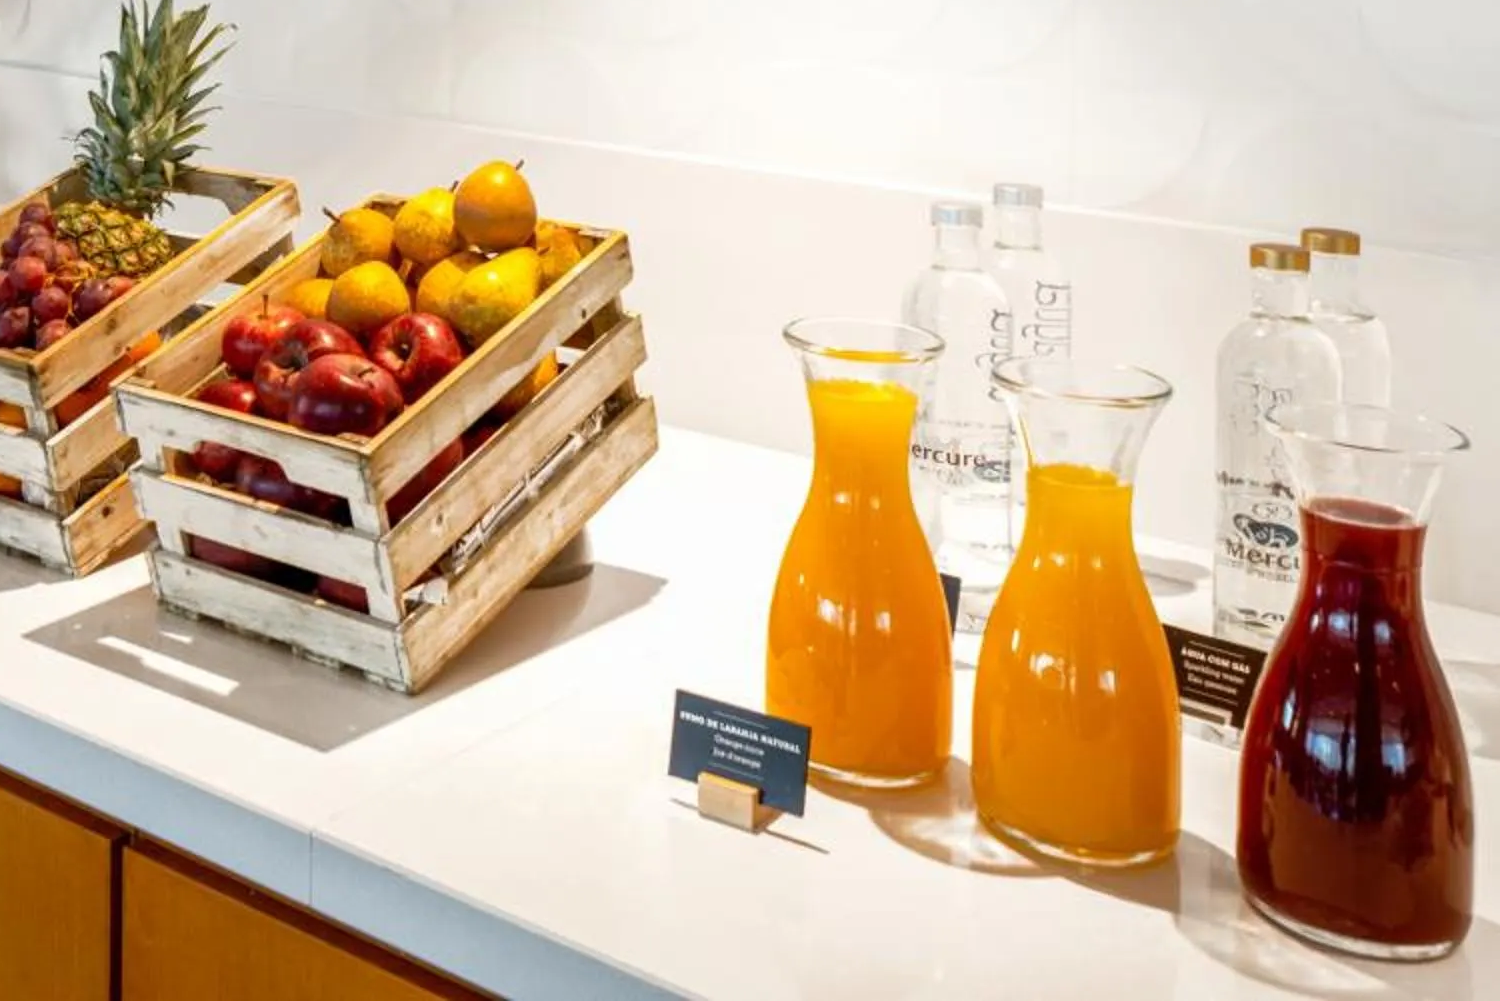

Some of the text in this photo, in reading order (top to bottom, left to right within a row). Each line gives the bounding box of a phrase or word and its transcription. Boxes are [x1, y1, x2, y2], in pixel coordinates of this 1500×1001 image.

[911, 443, 986, 467] ercure
[1225, 538, 1300, 570] Merc
[706, 718, 718, 730] DE
[719, 722, 759, 742] LARANJA
[760, 734, 801, 755] NATURAL
